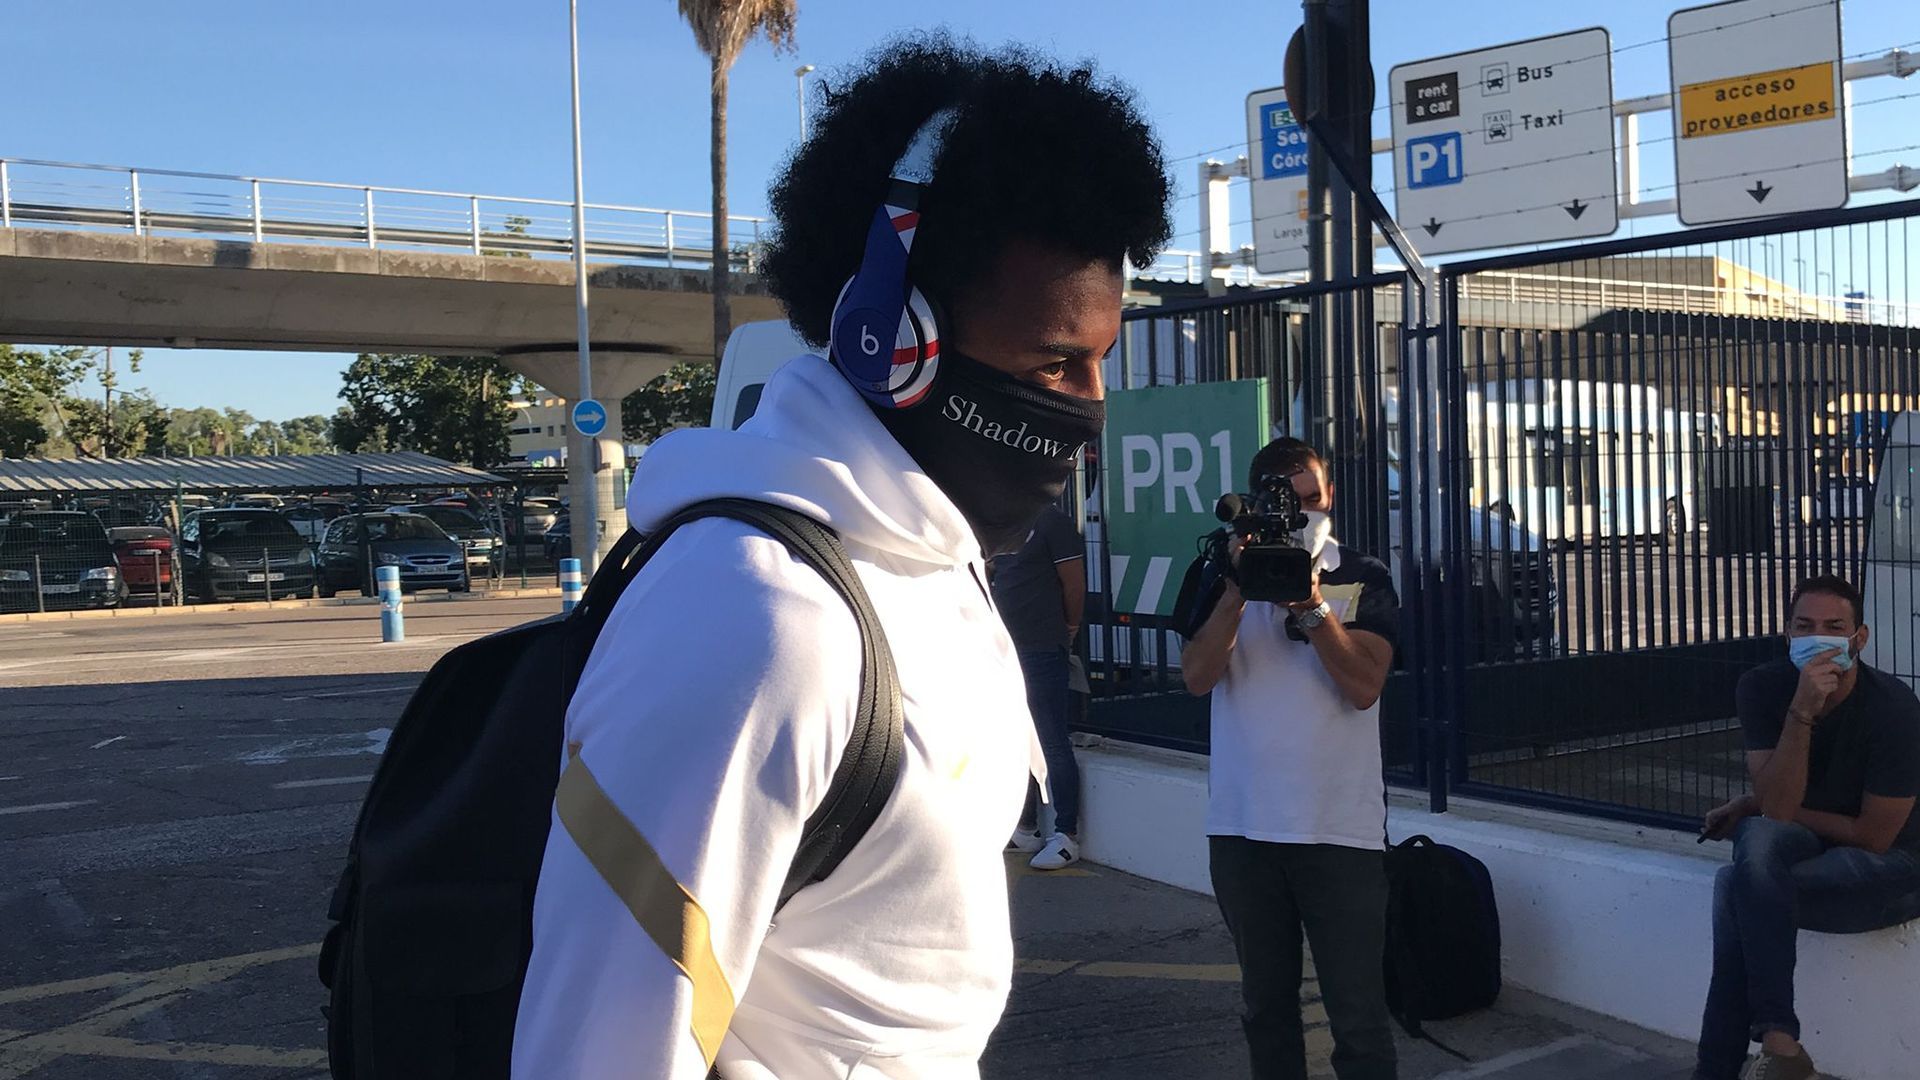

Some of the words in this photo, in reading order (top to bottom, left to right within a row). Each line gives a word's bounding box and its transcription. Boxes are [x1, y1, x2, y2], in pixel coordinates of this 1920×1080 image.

[1517, 66, 1553, 83] Bus
[1418, 82, 1449, 99] rent
[1715, 77, 1795, 102] acceso
[1416, 105, 1425, 117] a
[1429, 100, 1453, 114] car
[1520, 109, 1563, 130] Taxi
[1686, 100, 1829, 136] proveedores
[1411, 138, 1457, 184] P1
[861, 324, 880, 356] b
[942, 394, 1068, 459] Shadow
[1121, 429, 1233, 514] PR1
